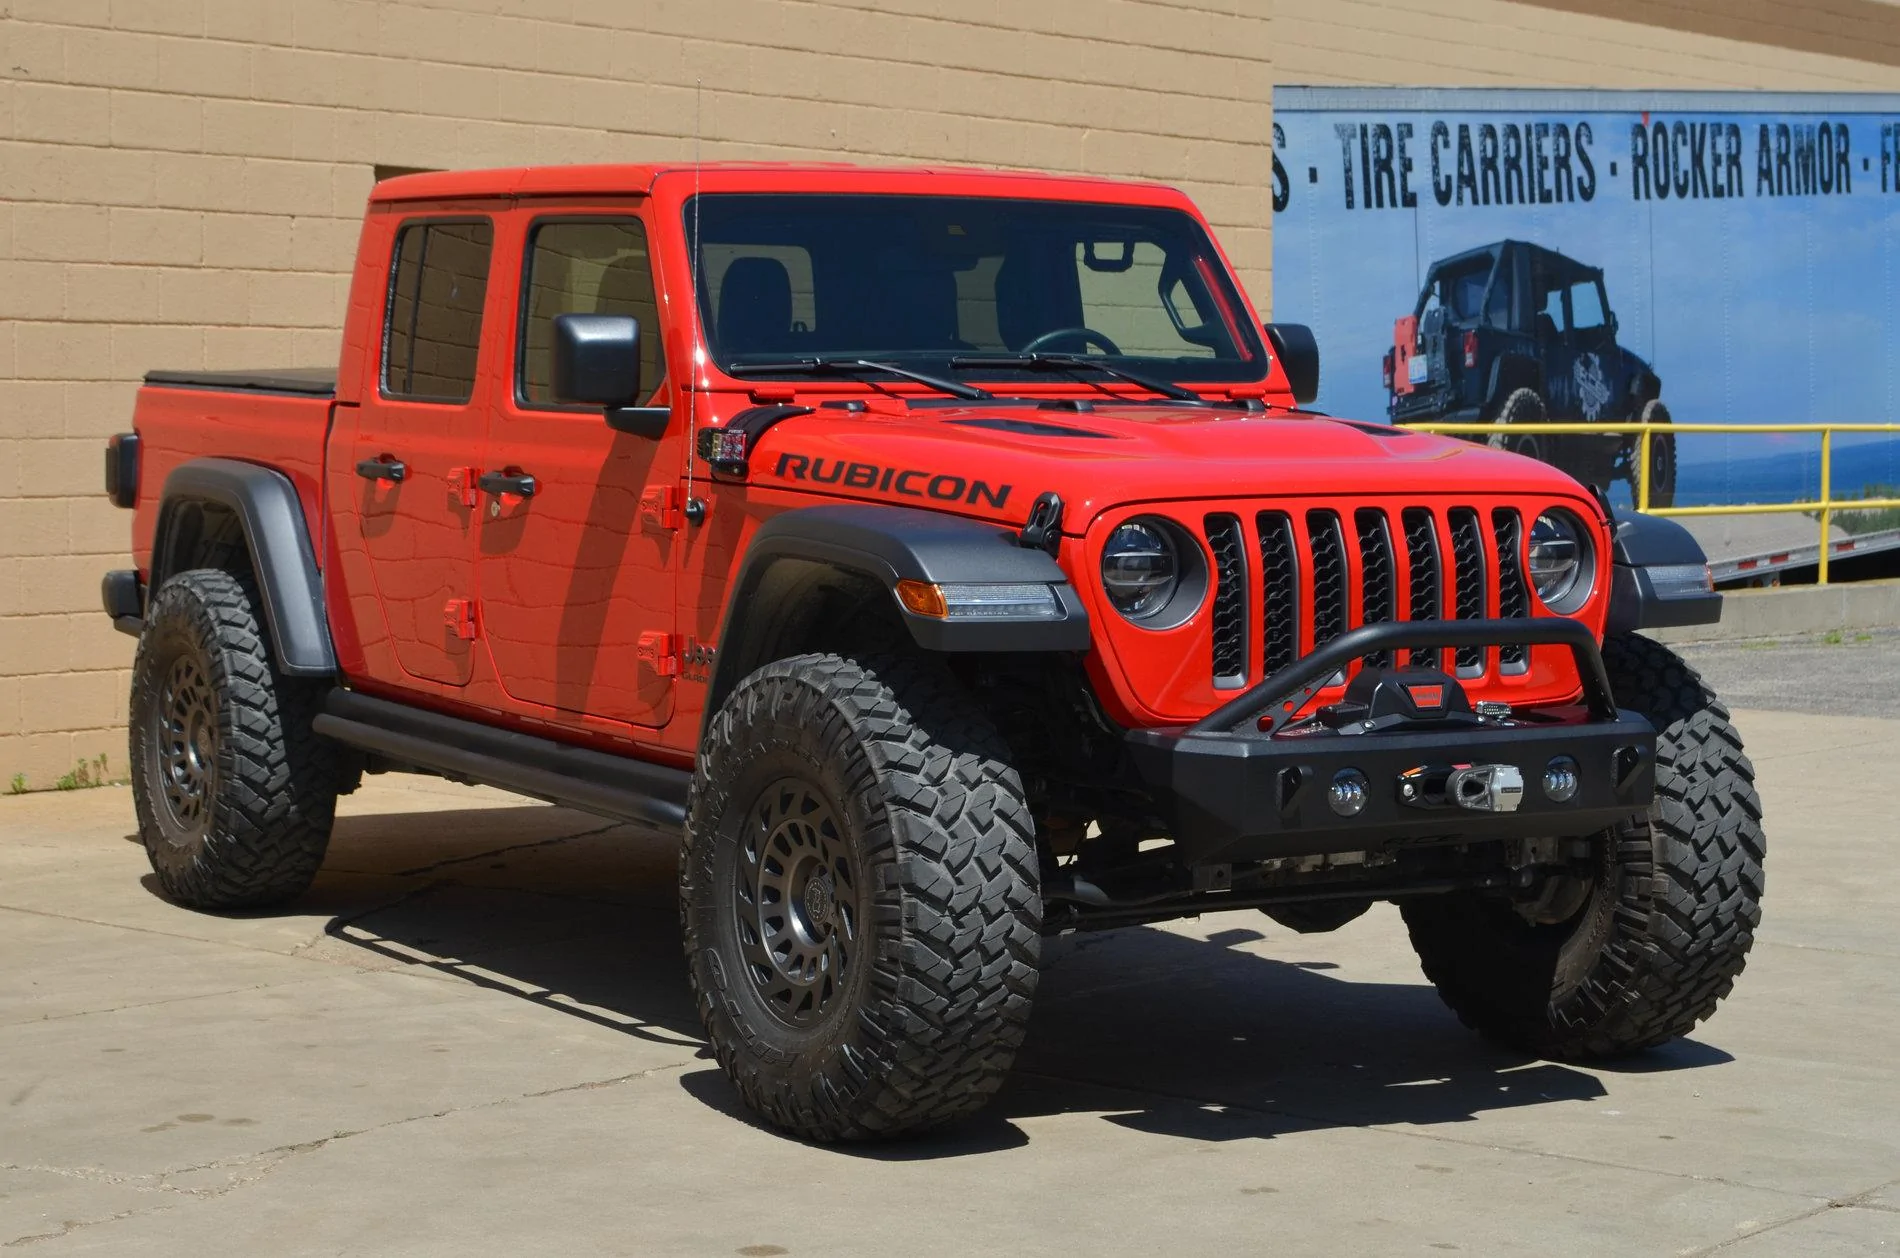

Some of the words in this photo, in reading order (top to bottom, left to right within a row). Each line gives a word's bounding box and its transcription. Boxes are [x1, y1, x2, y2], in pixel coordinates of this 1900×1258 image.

[1333, 122, 1417, 209] TIRE
[1431, 120, 1596, 206] CARRIERS
[1631, 120, 1744, 201] ROCKER
[1756, 121, 1851, 197] ARMOR
[775, 452, 1012, 509] RUBICON
[682, 634, 720, 667] Jee
